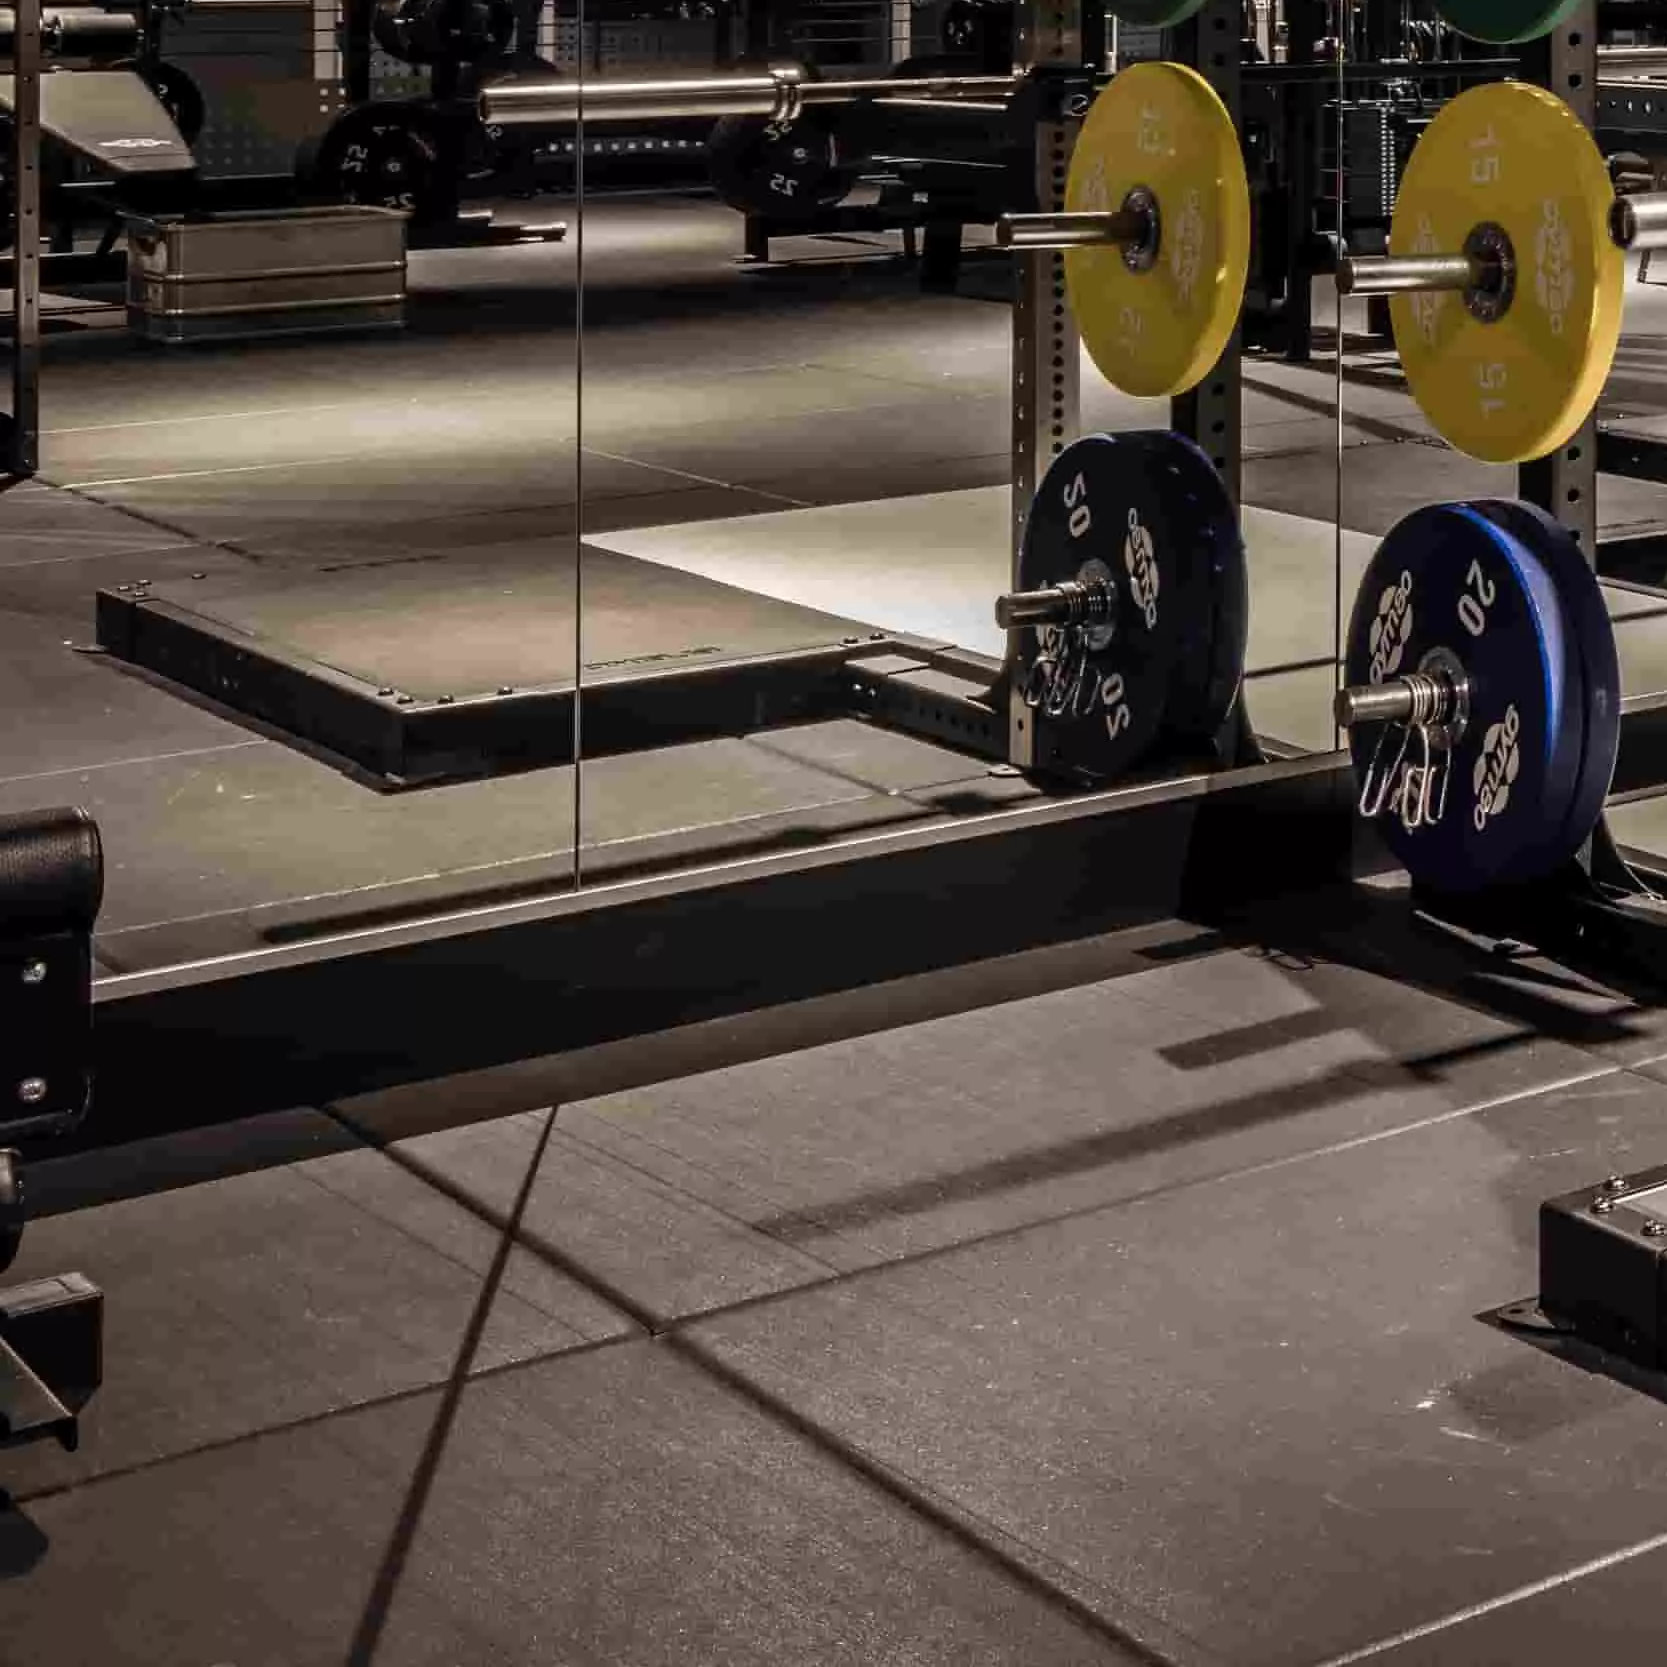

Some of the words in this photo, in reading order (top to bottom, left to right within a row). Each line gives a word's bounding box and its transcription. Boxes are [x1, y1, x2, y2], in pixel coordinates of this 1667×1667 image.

[1467, 123, 1502, 184] 15
[1473, 361, 1508, 420] 15
[1456, 558, 1497, 637] 20
